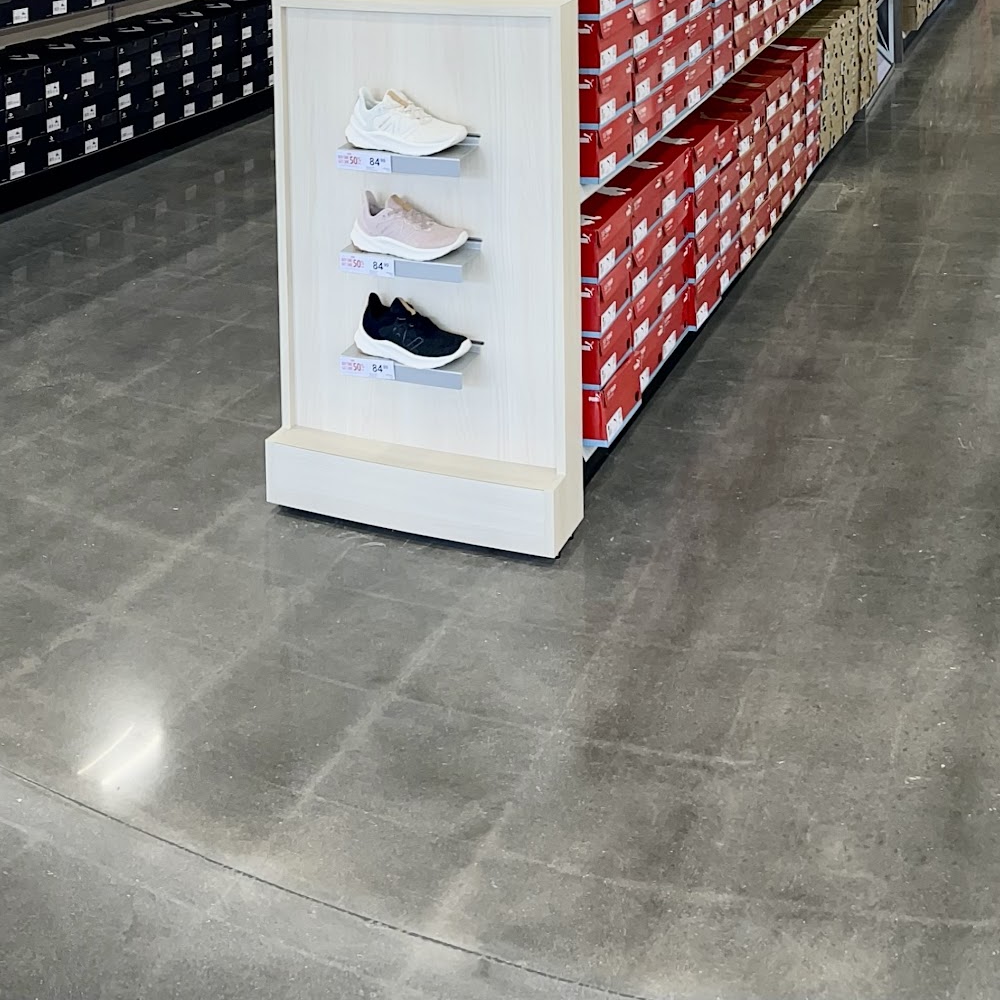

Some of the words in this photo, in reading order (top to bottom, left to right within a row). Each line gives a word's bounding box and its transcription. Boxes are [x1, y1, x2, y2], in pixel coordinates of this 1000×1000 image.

[369, 157, 380, 166] 84
[372, 261, 383, 270] 84
[372, 364, 383, 372] 84
